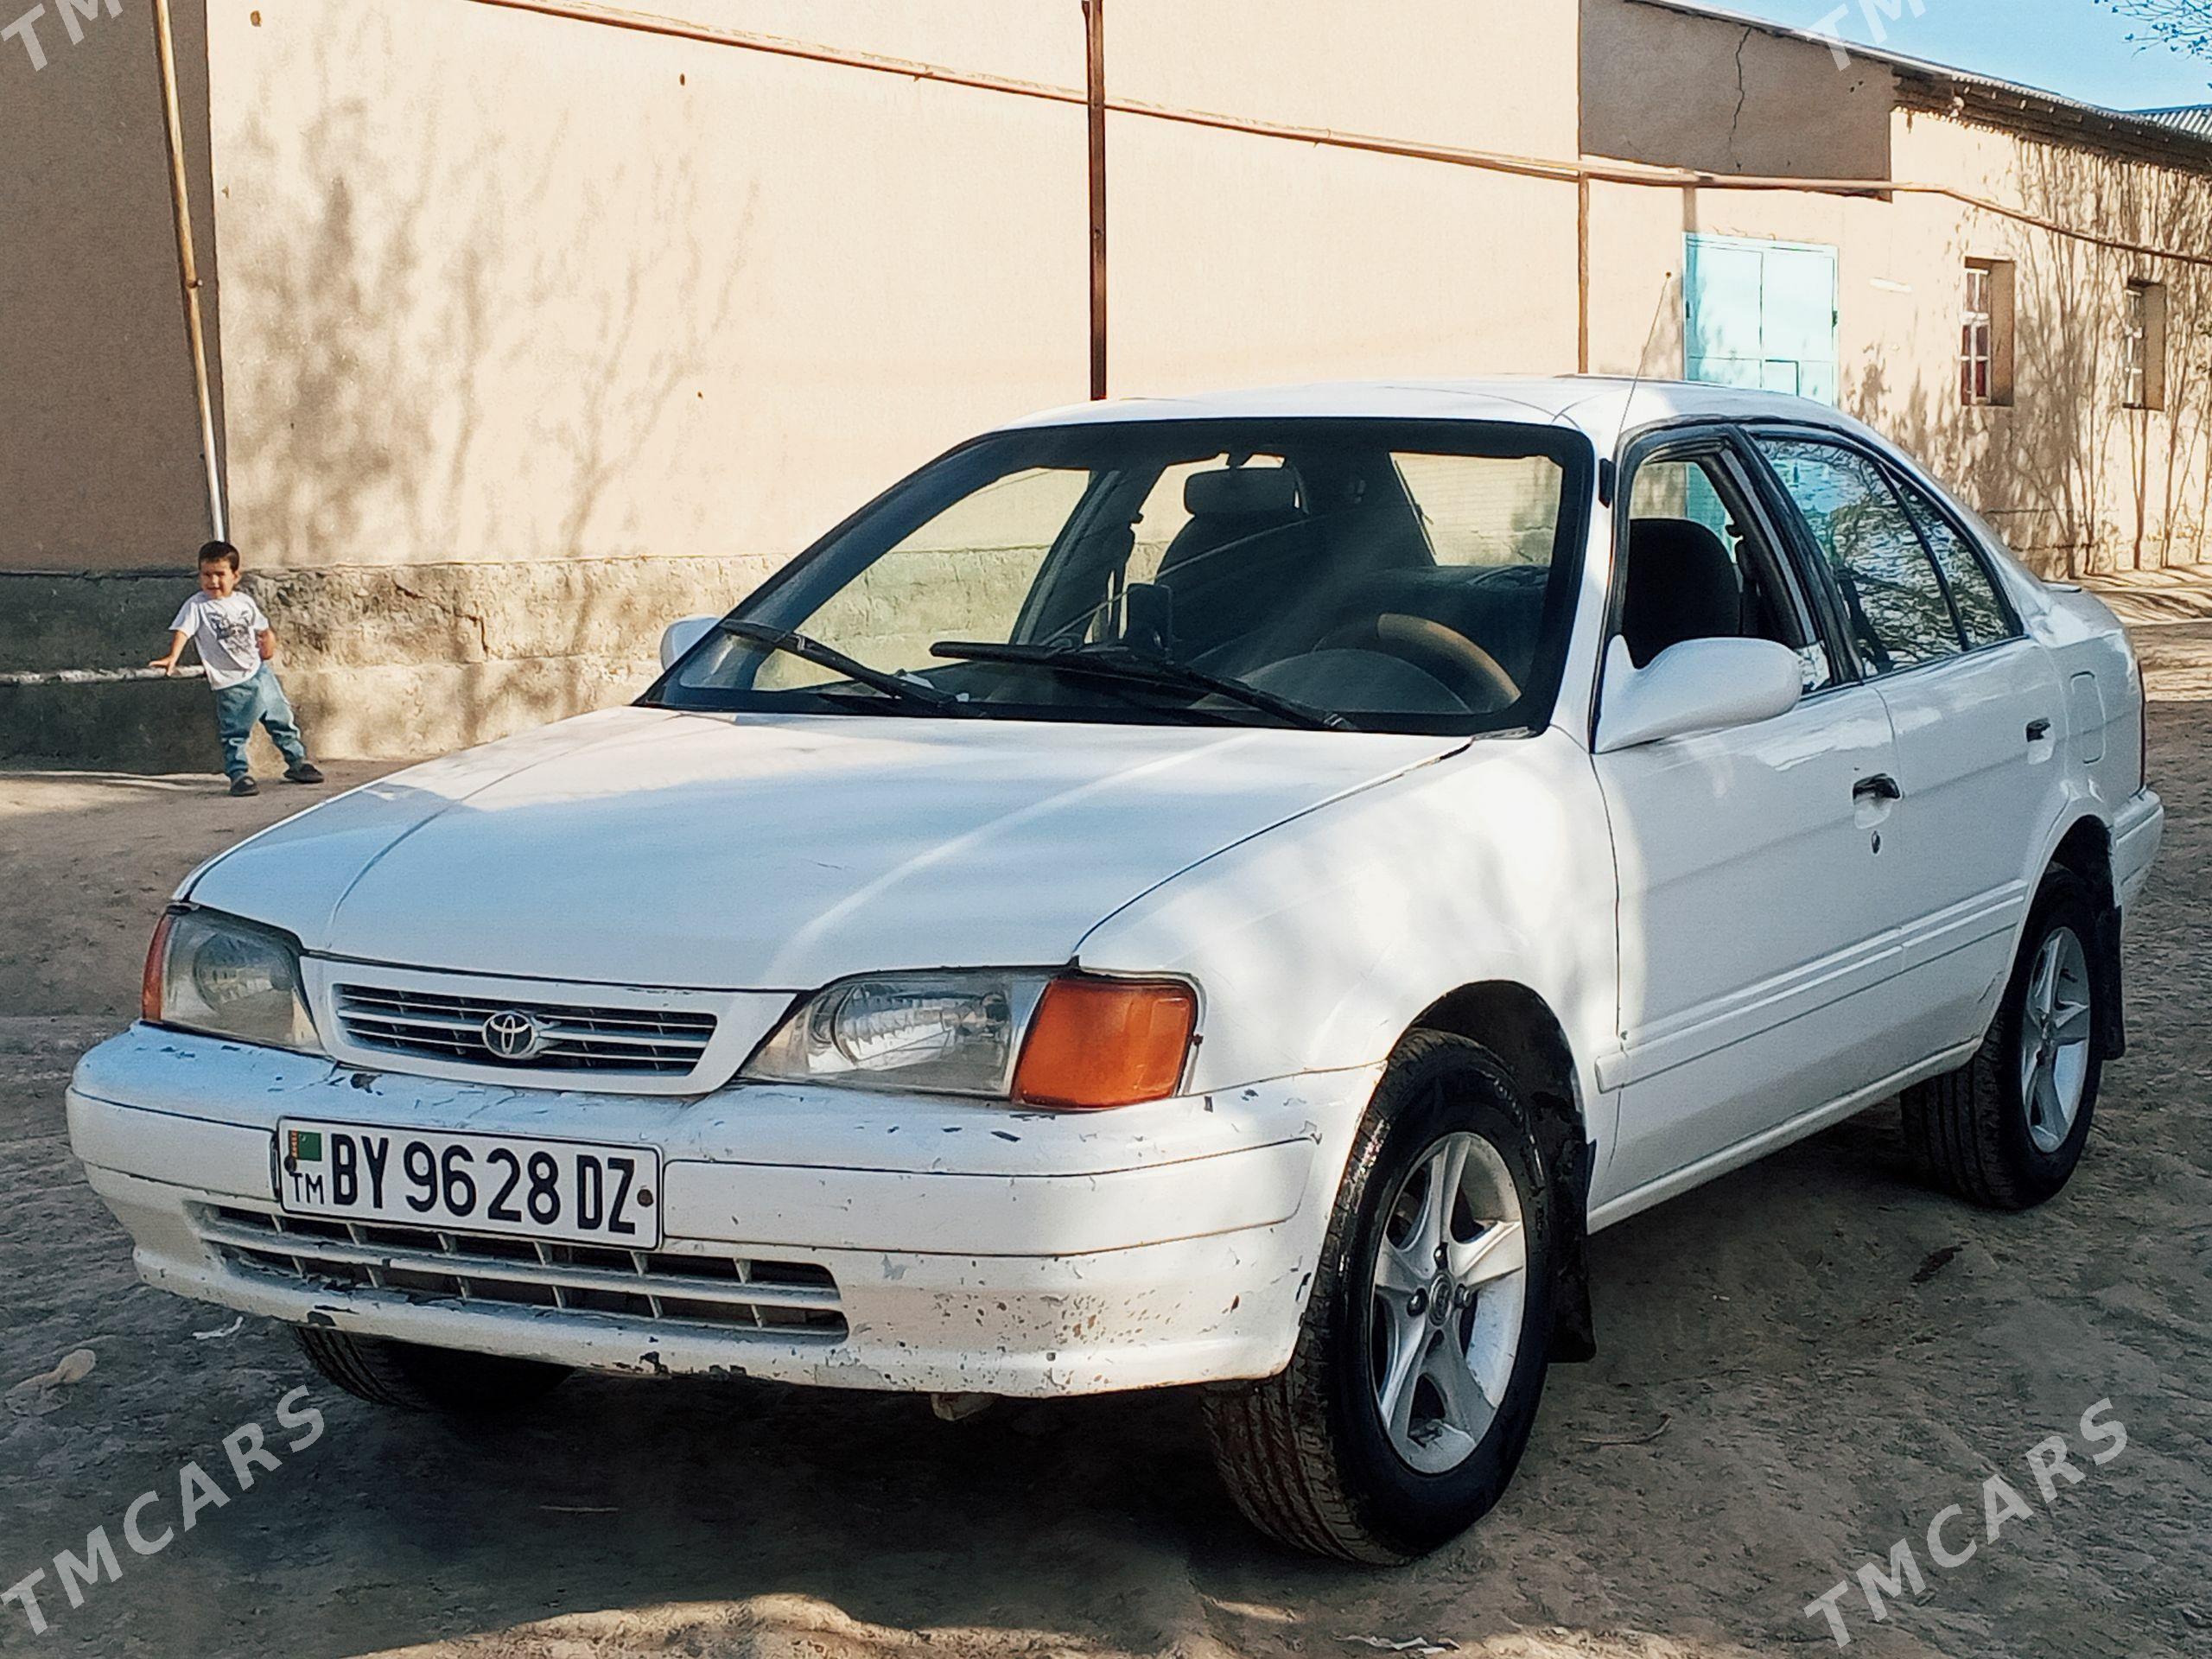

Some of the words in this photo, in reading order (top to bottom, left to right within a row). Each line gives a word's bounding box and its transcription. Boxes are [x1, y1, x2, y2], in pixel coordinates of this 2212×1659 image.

[289, 1172, 324, 1205] TM
[403, 1141, 561, 1225] 9628
[576, 1154, 636, 1235] DZ
